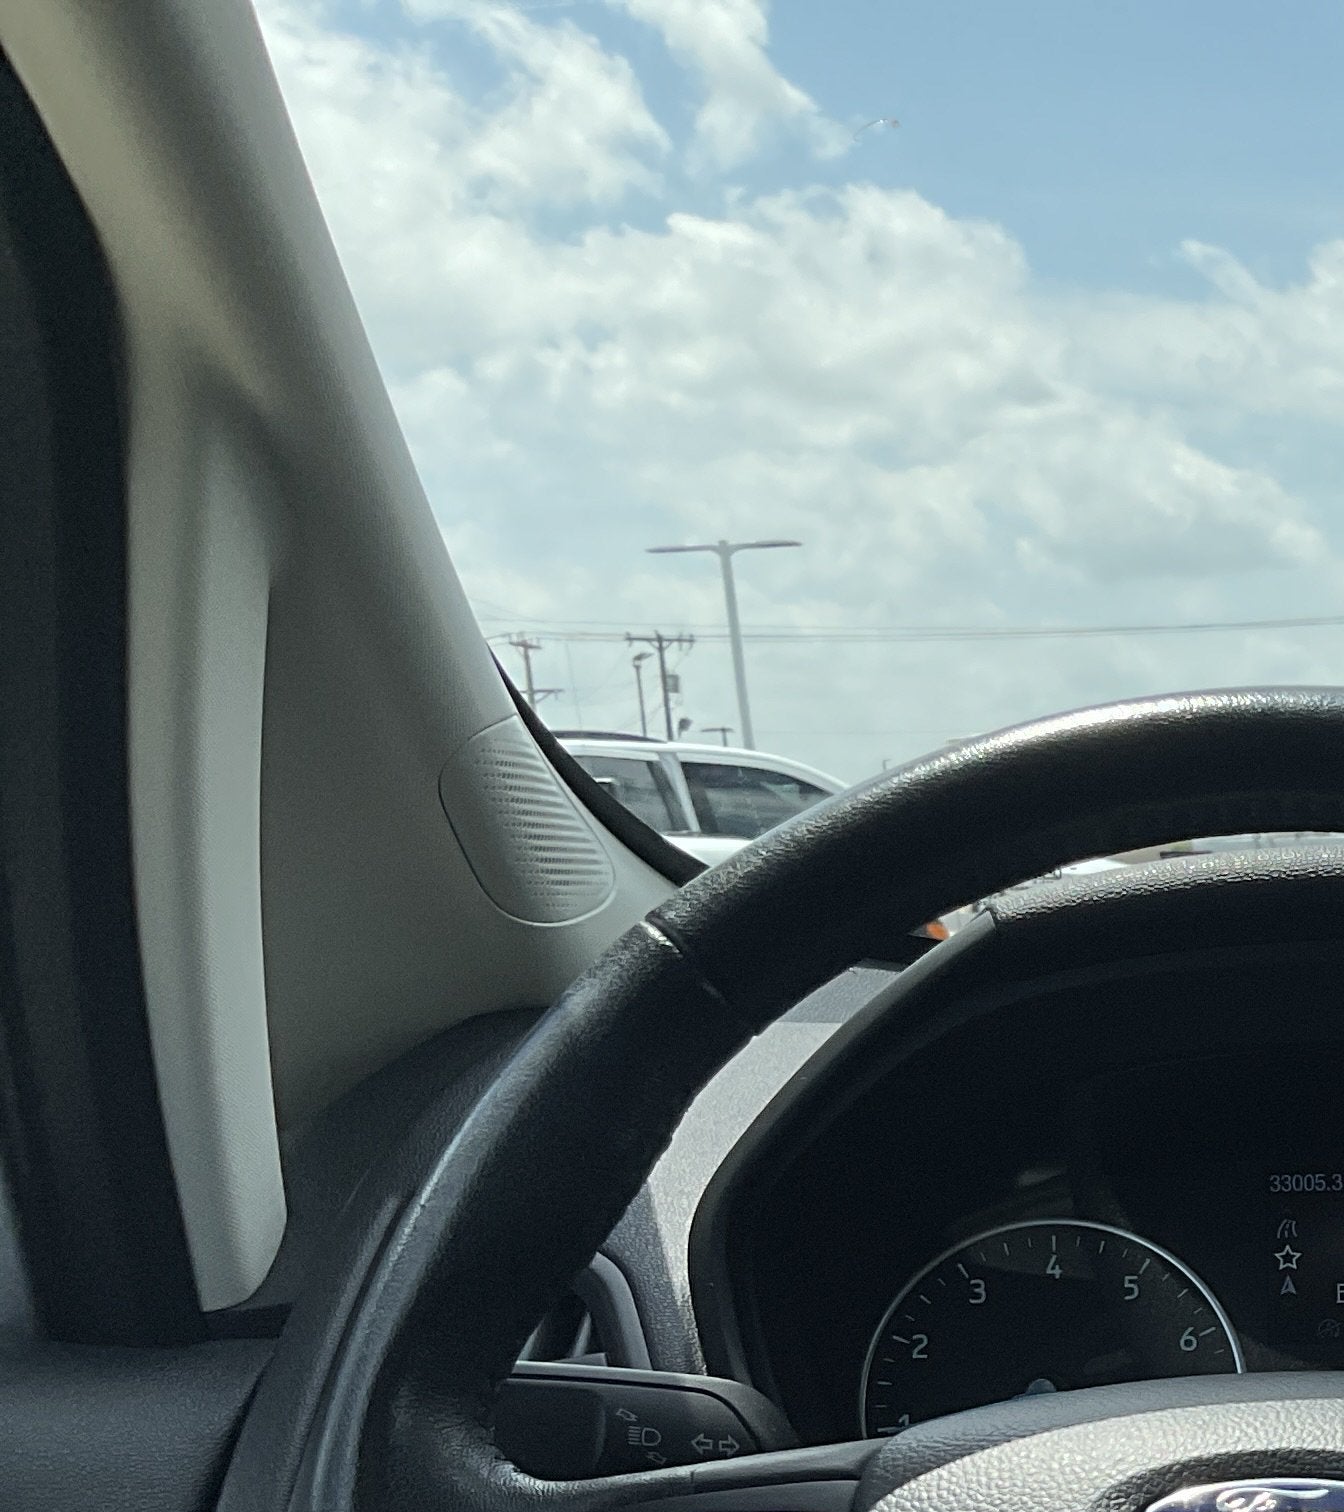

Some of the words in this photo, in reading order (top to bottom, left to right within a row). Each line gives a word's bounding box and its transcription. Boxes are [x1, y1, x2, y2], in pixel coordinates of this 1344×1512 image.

[1269, 1174, 1343, 1192] 33005.3
[1045, 1255, 1062, 1279] 4
[969, 1279, 987, 1303] 3
[1123, 1275, 1139, 1300] 5
[912, 1334, 928, 1359] 2
[1179, 1327, 1197, 1351] 6
